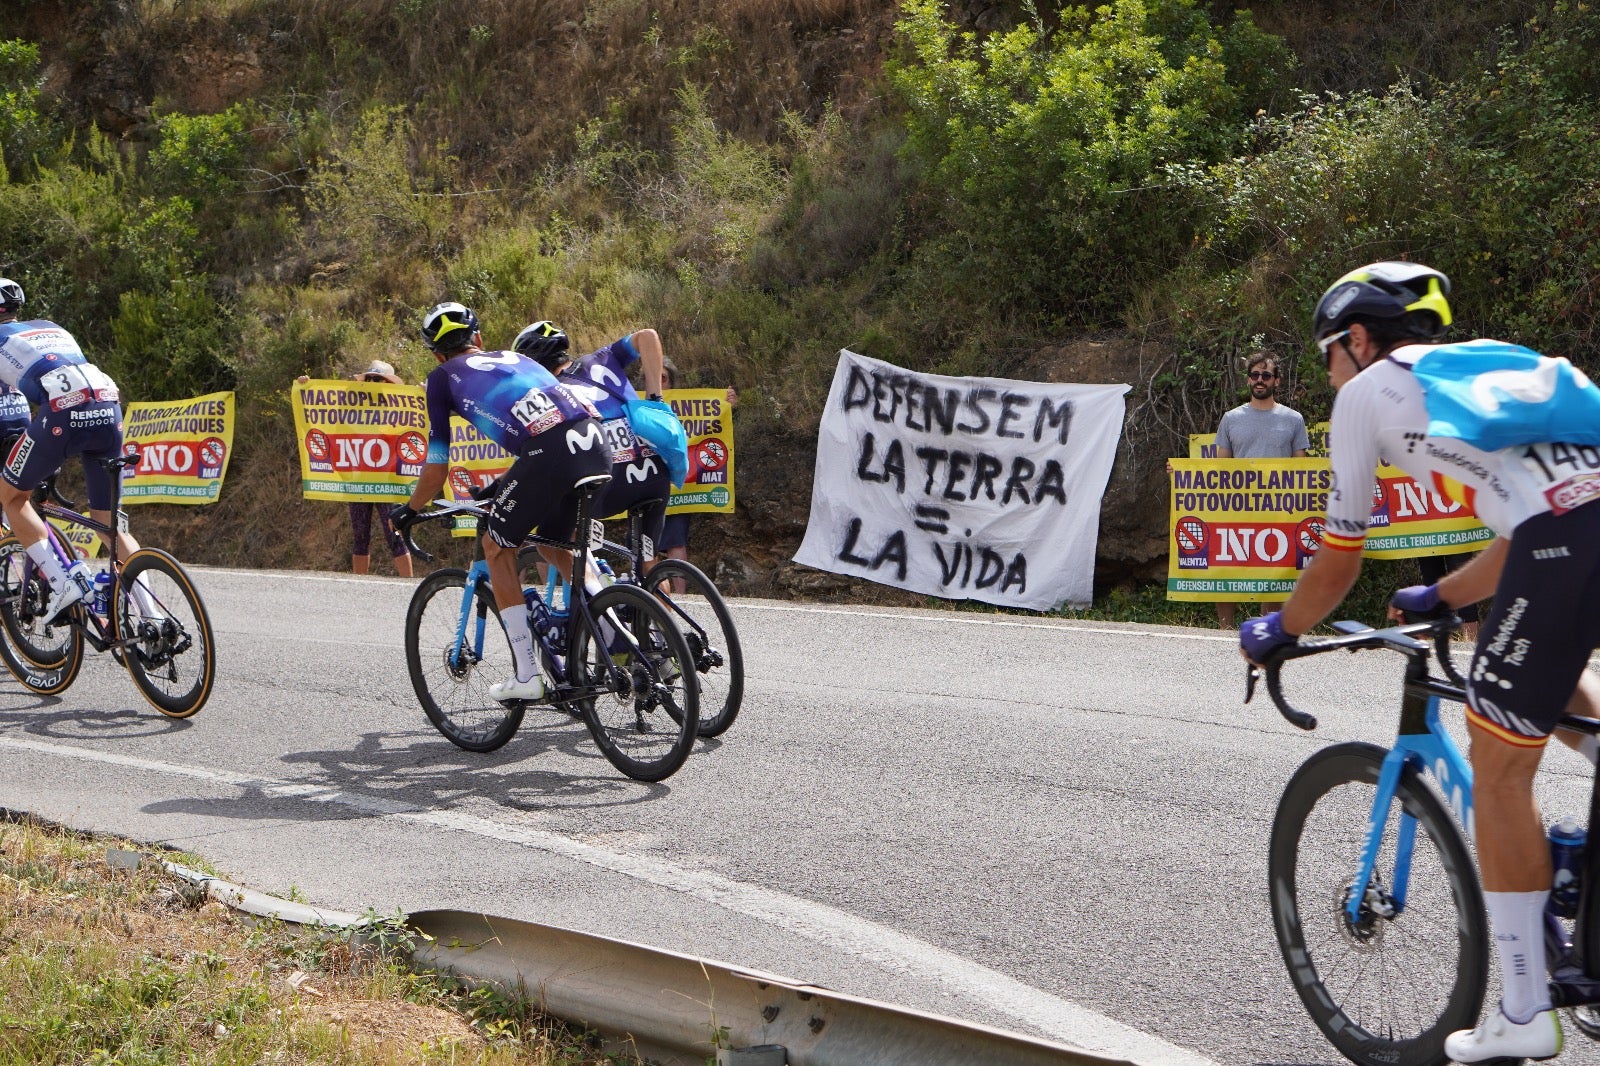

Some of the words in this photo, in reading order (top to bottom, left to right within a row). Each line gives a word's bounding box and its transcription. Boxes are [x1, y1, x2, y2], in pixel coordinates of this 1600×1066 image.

[56, 373, 71, 393] 3
[0, 394, 26, 407] ENSON
[300, 389, 426, 411] MACROPLANTES
[842, 364, 1076, 445] DEFENSEM
[70, 408, 114, 420] RENSON
[70, 417, 114, 427] OUTDOOR
[129, 401, 226, 423] MACROPLANTES
[304, 408, 426, 428] FOTOVOLTAIQUES
[125, 418, 225, 439] FOTOVOLTAIQUES
[606, 426, 632, 451] 48
[11, 440, 33, 475] SOUDAL
[140, 444, 193, 473] NO
[335, 438, 390, 468] NO
[613, 454, 631, 462] POZO
[202, 467, 220, 478] MAT
[401, 464, 422, 476] MAT
[701, 471, 723, 483] MAT
[858, 432, 906, 493] LA
[916, 447, 1067, 506] TERRA
[365, 484, 374, 493] DE
[375, 484, 406, 494] CABANES
[1174, 470, 1330, 490] MACROPLANTES
[167, 487, 176, 496] DE
[177, 487, 207, 496] CABANES
[675, 494, 708, 504] CABANES
[1175, 492, 1329, 515] FOTOVOLTAIQUES
[592, 522, 602, 544] 142
[1364, 538, 1399, 550] EFENSEM
[1400, 537, 1408, 547] EL
[1410, 535, 1437, 547] TERME
[1438, 534, 1448, 545] DE
[1450, 529, 1490, 545] CABANES
[839, 518, 908, 582] LA
[1215, 528, 1288, 562] NO
[1179, 557, 1208, 567] VALENTIA
[1176, 580, 1214, 591] DEFENSEM
[1216, 581, 1225, 591] EL
[1228, 581, 1256, 592] TERME
[1258, 581, 1269, 592] DE
[1270, 582, 1297, 592] CABAN
